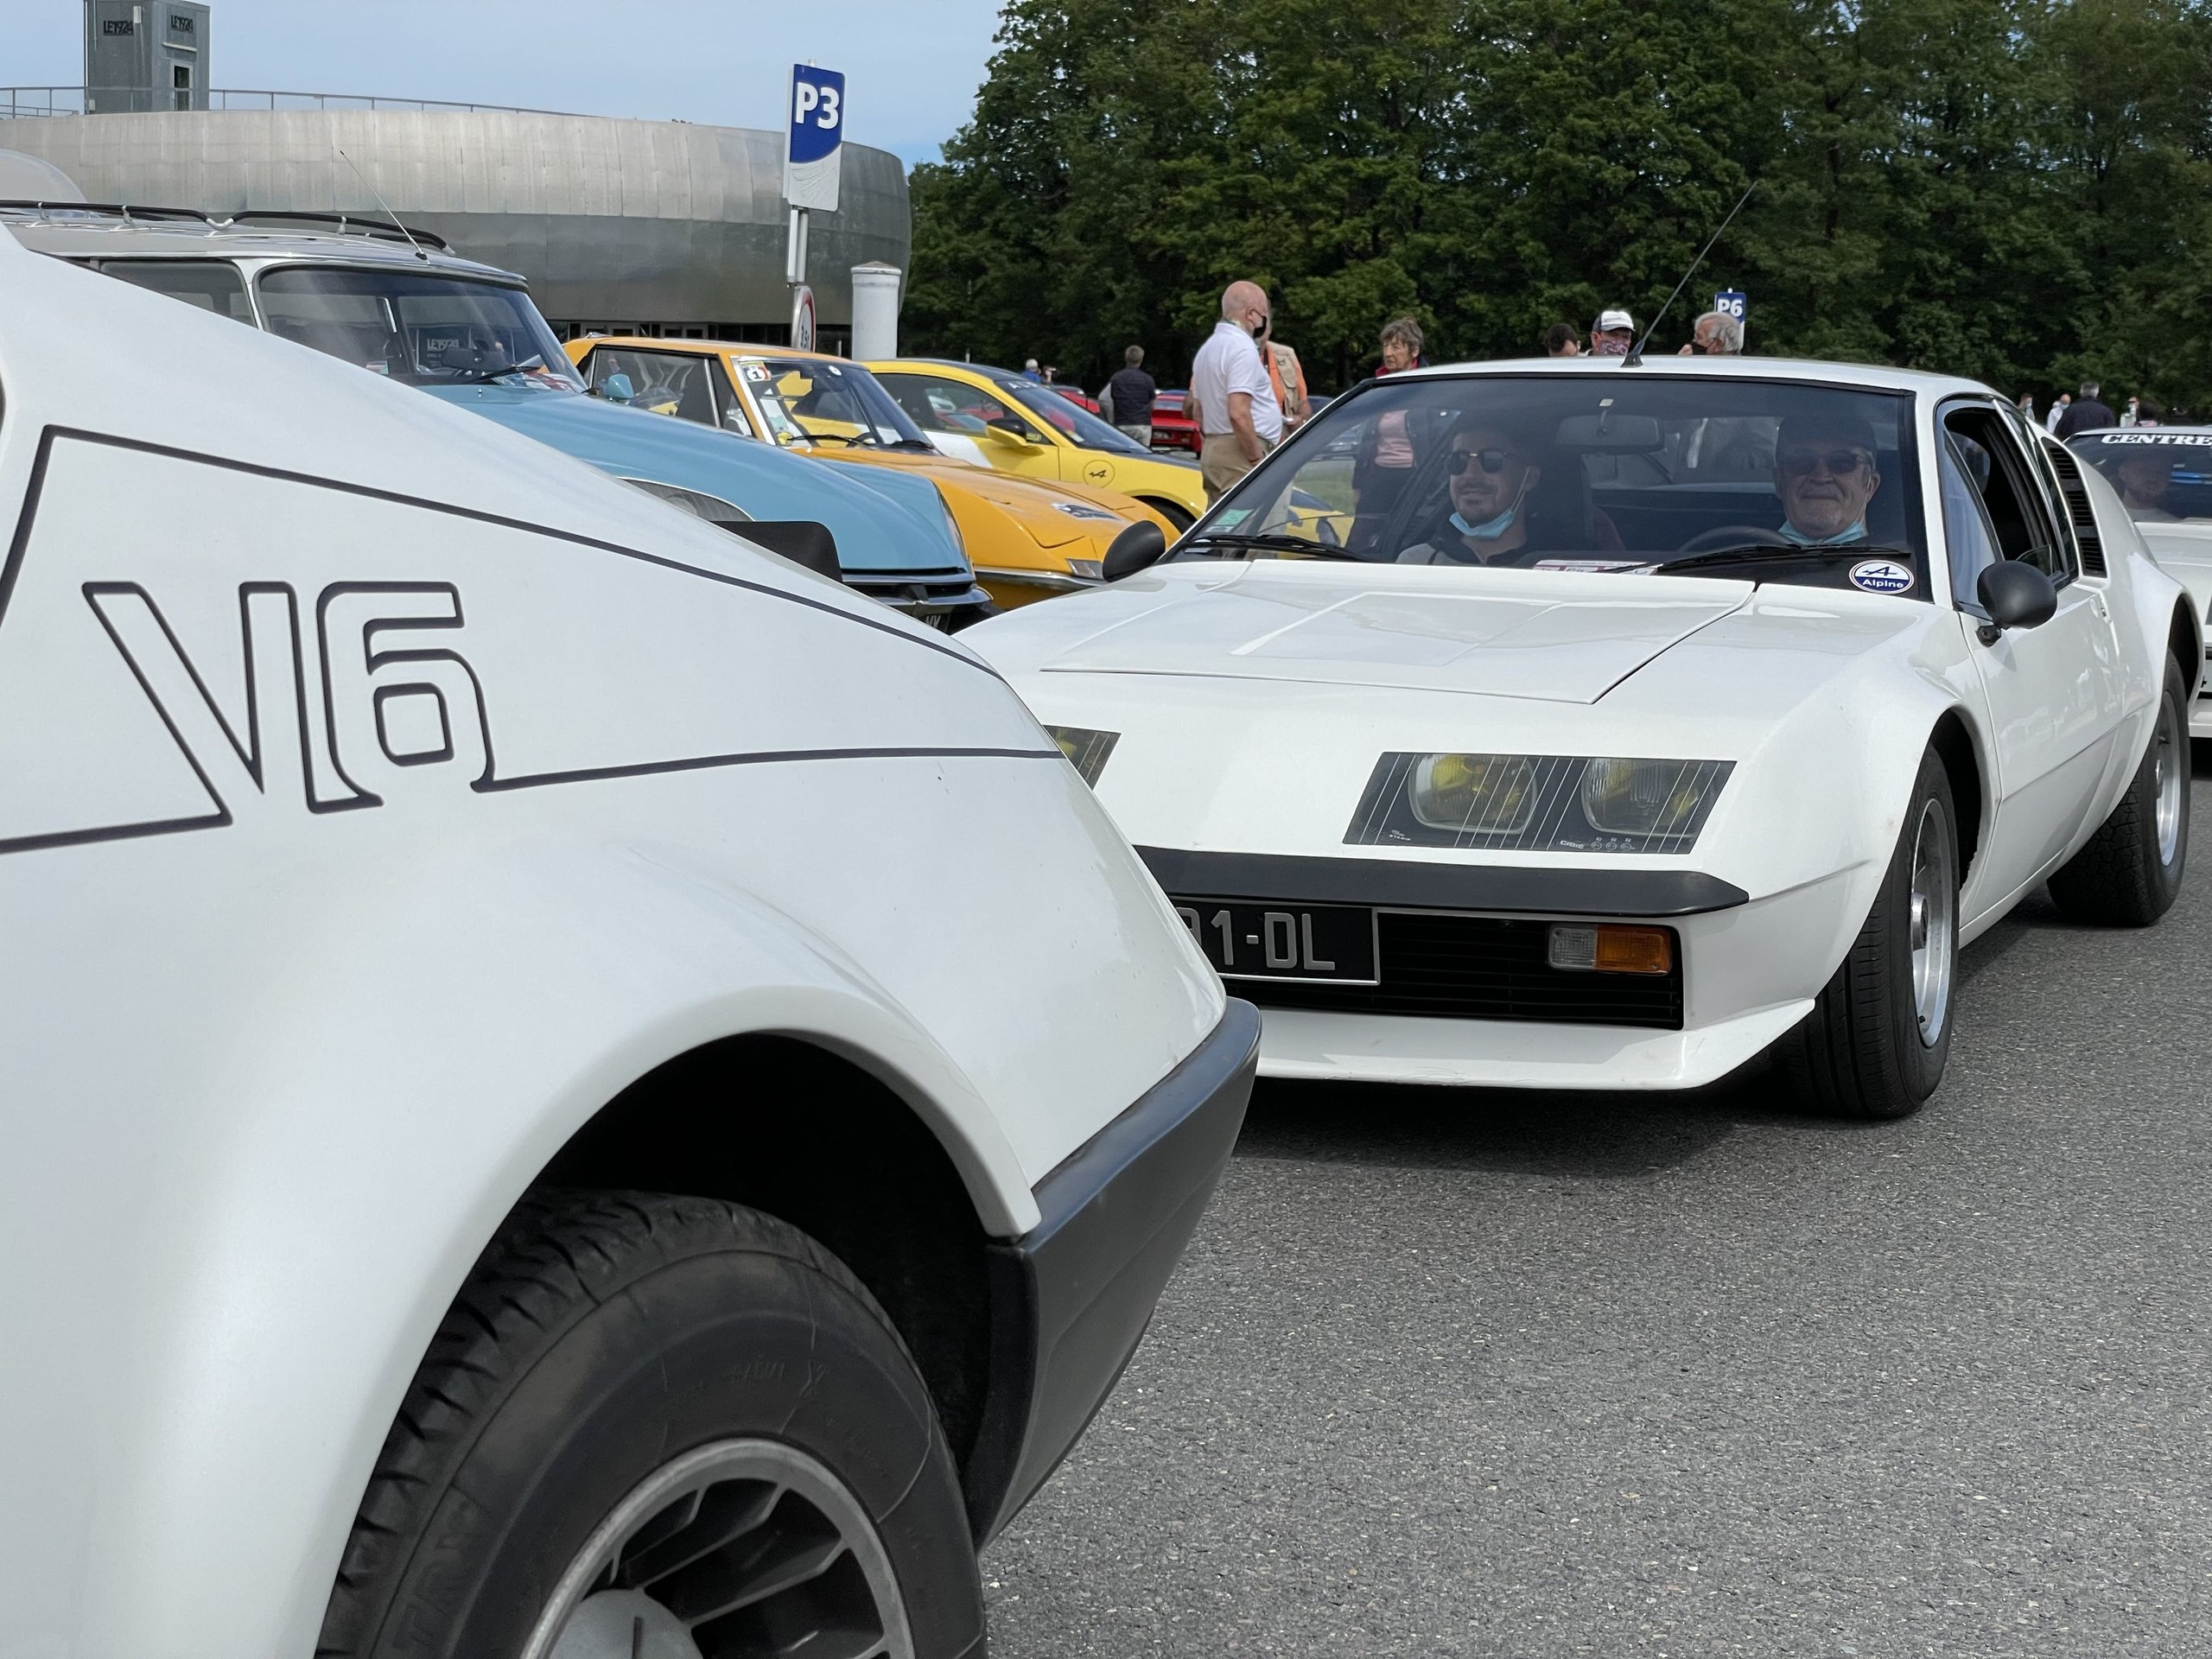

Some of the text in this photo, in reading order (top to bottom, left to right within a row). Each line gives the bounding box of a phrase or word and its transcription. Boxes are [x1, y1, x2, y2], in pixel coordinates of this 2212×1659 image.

[796, 81, 840, 130] P3
[1717, 298, 1744, 318] P6
[2101, 433, 2212, 447] CENTRE
[1862, 578, 1904, 588] Alpine
[81, 581, 495, 826] V6
